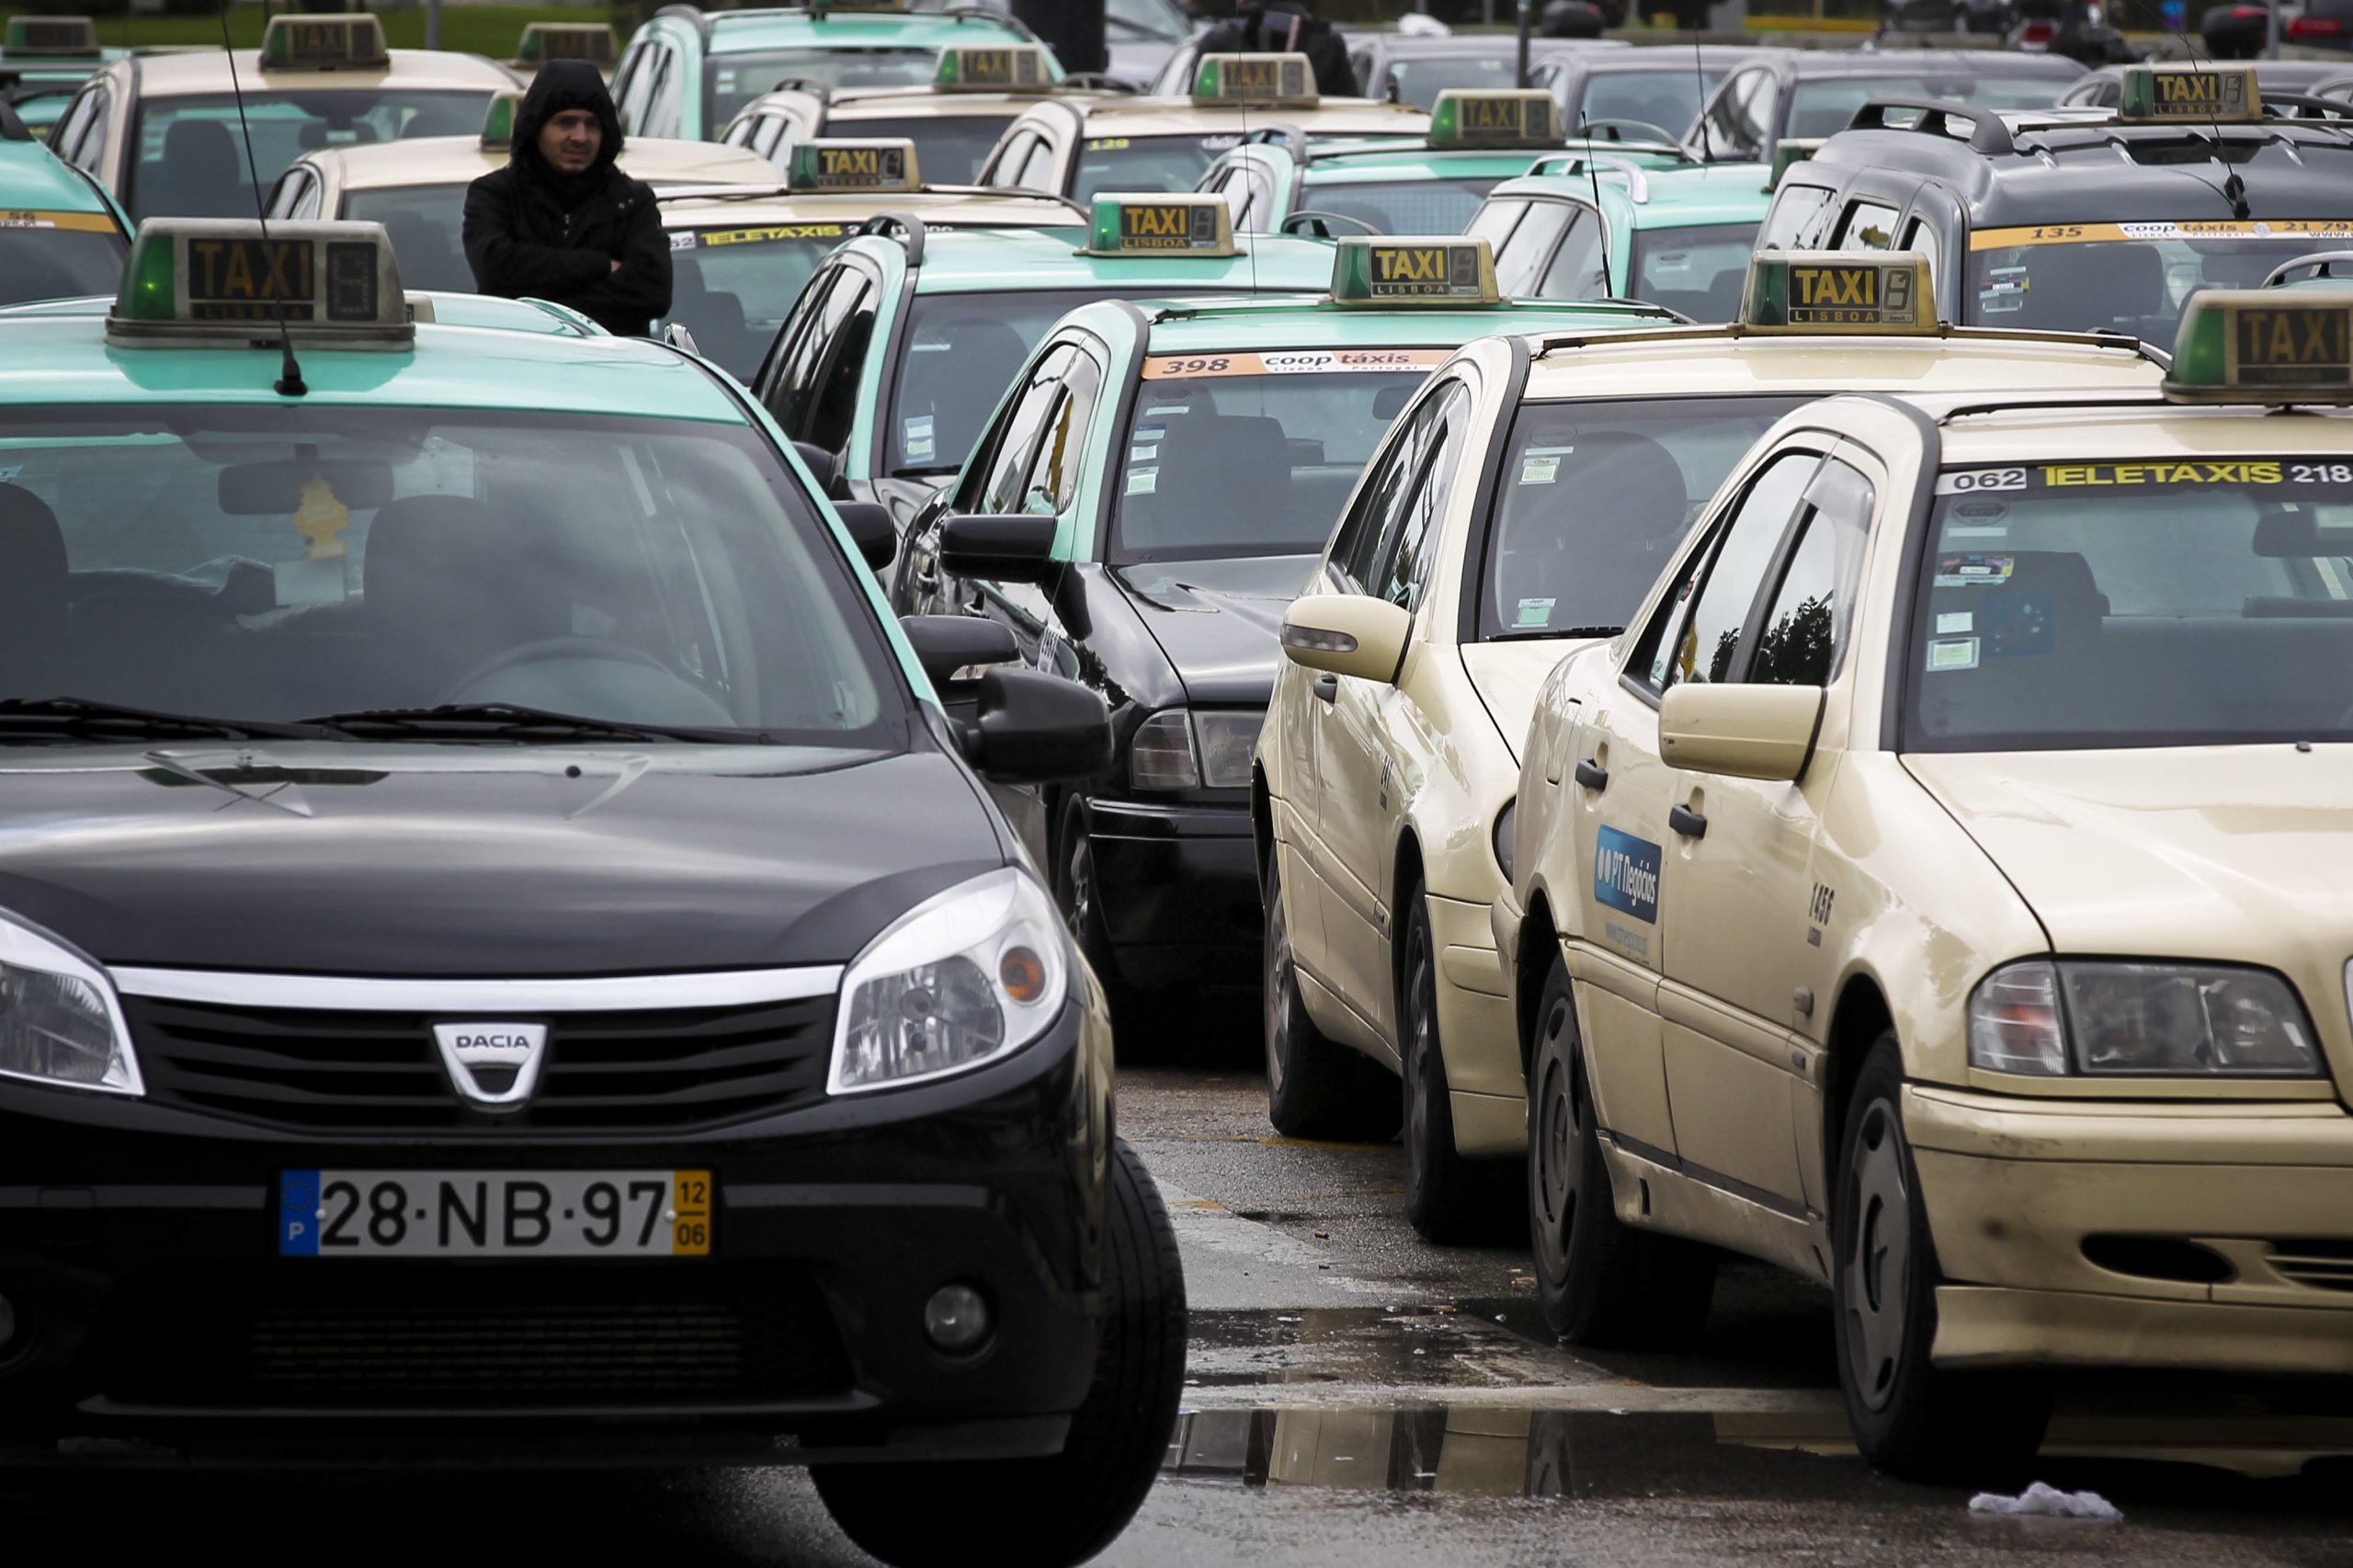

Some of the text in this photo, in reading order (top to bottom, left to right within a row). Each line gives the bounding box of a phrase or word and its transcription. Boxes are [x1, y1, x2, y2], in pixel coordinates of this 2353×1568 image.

[962, 51, 1011, 73] TAXI
[1225, 62, 1276, 85] TAXI
[2157, 75, 2216, 101] TAXI
[1464, 101, 1519, 126] TAXI
[822, 150, 878, 174] TAXI
[1125, 208, 1186, 234] TAXI
[2031, 226, 2083, 239] 135
[2123, 224, 2176, 233] coop
[2184, 222, 2237, 231] táxis
[2284, 222, 2310, 231] 21
[700, 224, 843, 245] TELETAXIS
[1124, 239, 1187, 248] LISBOA
[195, 243, 310, 297] TAXI
[1376, 250, 1444, 279] TAXI
[1377, 286, 1445, 294] LISBOA
[1795, 269, 1874, 304] TAXI
[1795, 311, 1874, 322] LISBOA
[2243, 312, 2347, 362] TAXI
[1162, 353, 1410, 374] 398 coop táxis
[1953, 471, 2025, 489] 062
[2291, 466, 2353, 483] 218
[1611, 851, 1656, 907] PT Negócios
[1809, 882, 1835, 926] 1456
[455, 1035, 530, 1050] DACIA
[289, 1222, 304, 1240] P
[680, 1182, 706, 1204] 12
[677, 1223, 706, 1245] 06
